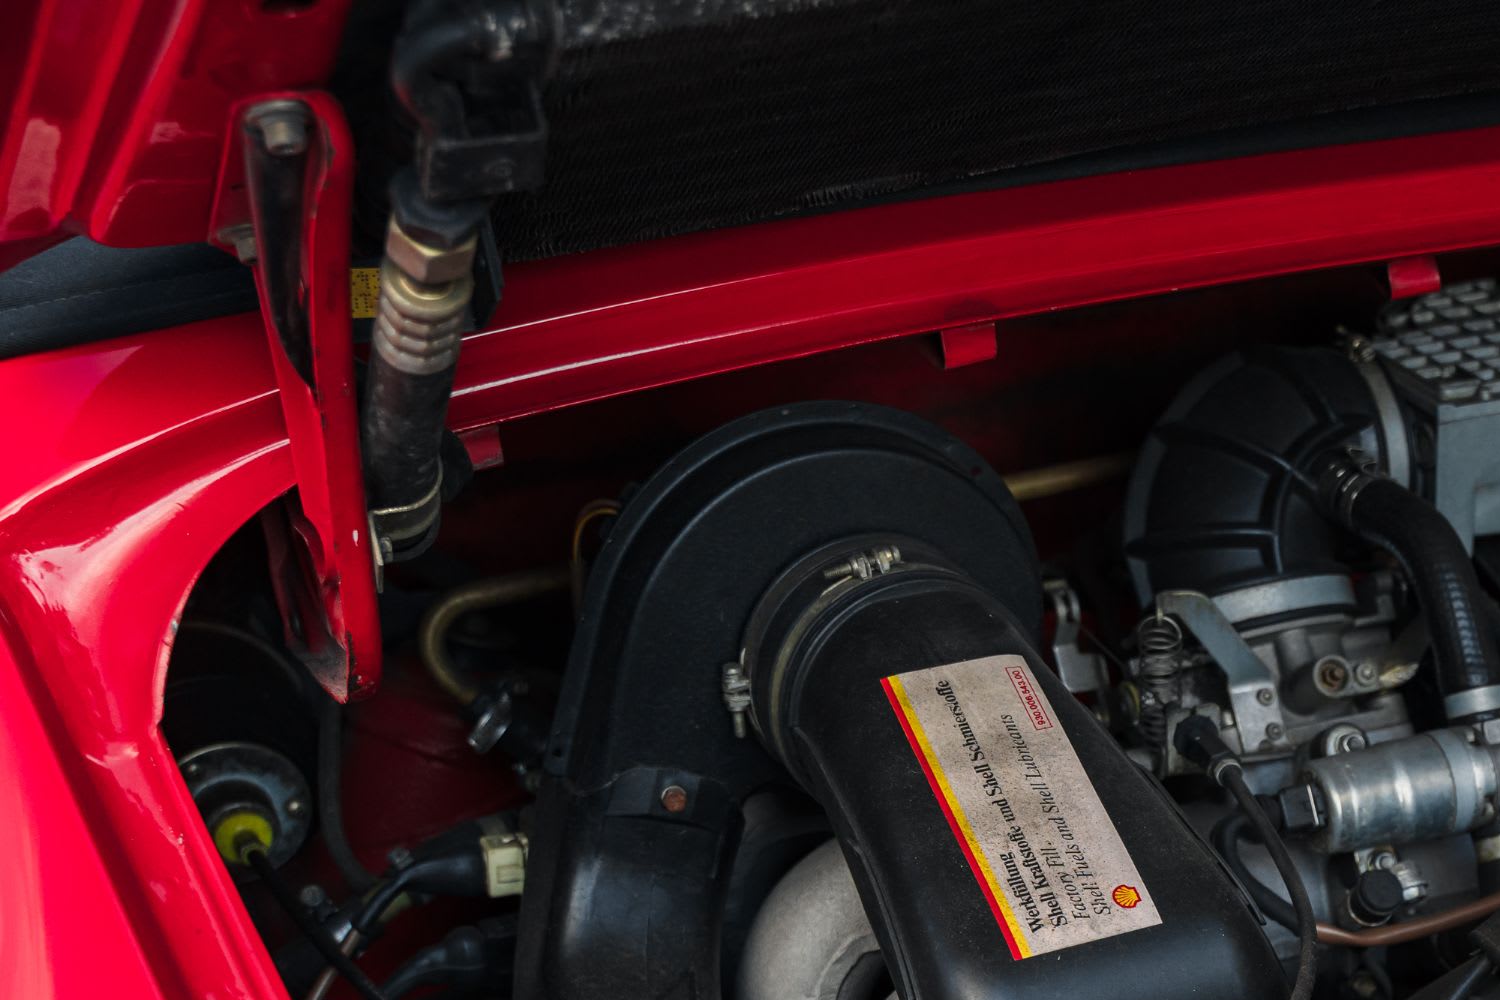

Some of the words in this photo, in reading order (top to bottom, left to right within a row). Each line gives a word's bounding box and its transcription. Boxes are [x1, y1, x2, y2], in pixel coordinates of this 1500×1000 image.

[935, 679, 985, 761] Schmierstoffe
[1000, 714, 1042, 780] Lubricants
[973, 763, 1003, 796] Shell
[1029, 782, 1059, 813] Shell
[991, 798, 1015, 822] und
[1048, 816, 1074, 840] and
[1006, 825, 1050, 890] Kraftstoffe
[1064, 843, 1093, 878] Fuels
[999, 851, 1044, 933] Werkfüllung
[1038, 891, 1068, 928] Shell
[1055, 871, 1090, 919] Factory
